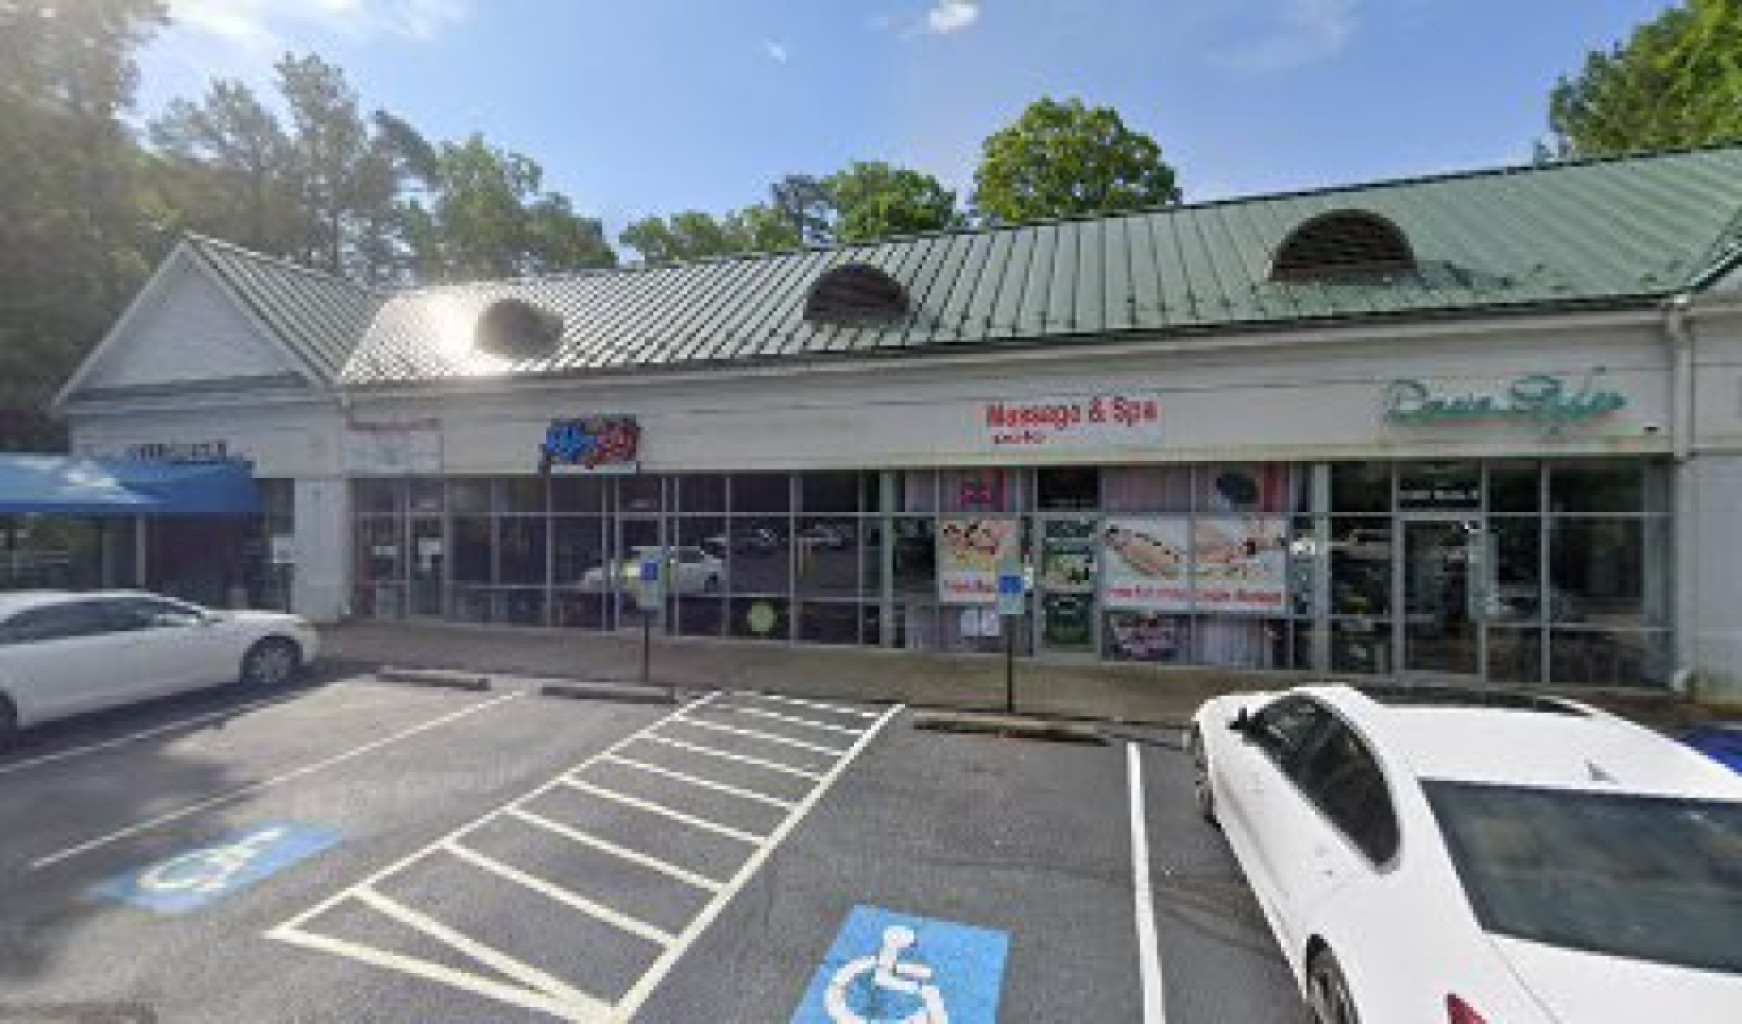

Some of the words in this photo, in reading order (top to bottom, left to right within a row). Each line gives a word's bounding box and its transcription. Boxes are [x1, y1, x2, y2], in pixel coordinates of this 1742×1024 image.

[986, 403, 1081, 431] Massage
[1088, 396, 1107, 423] &
[1113, 395, 1158, 428] Spa
